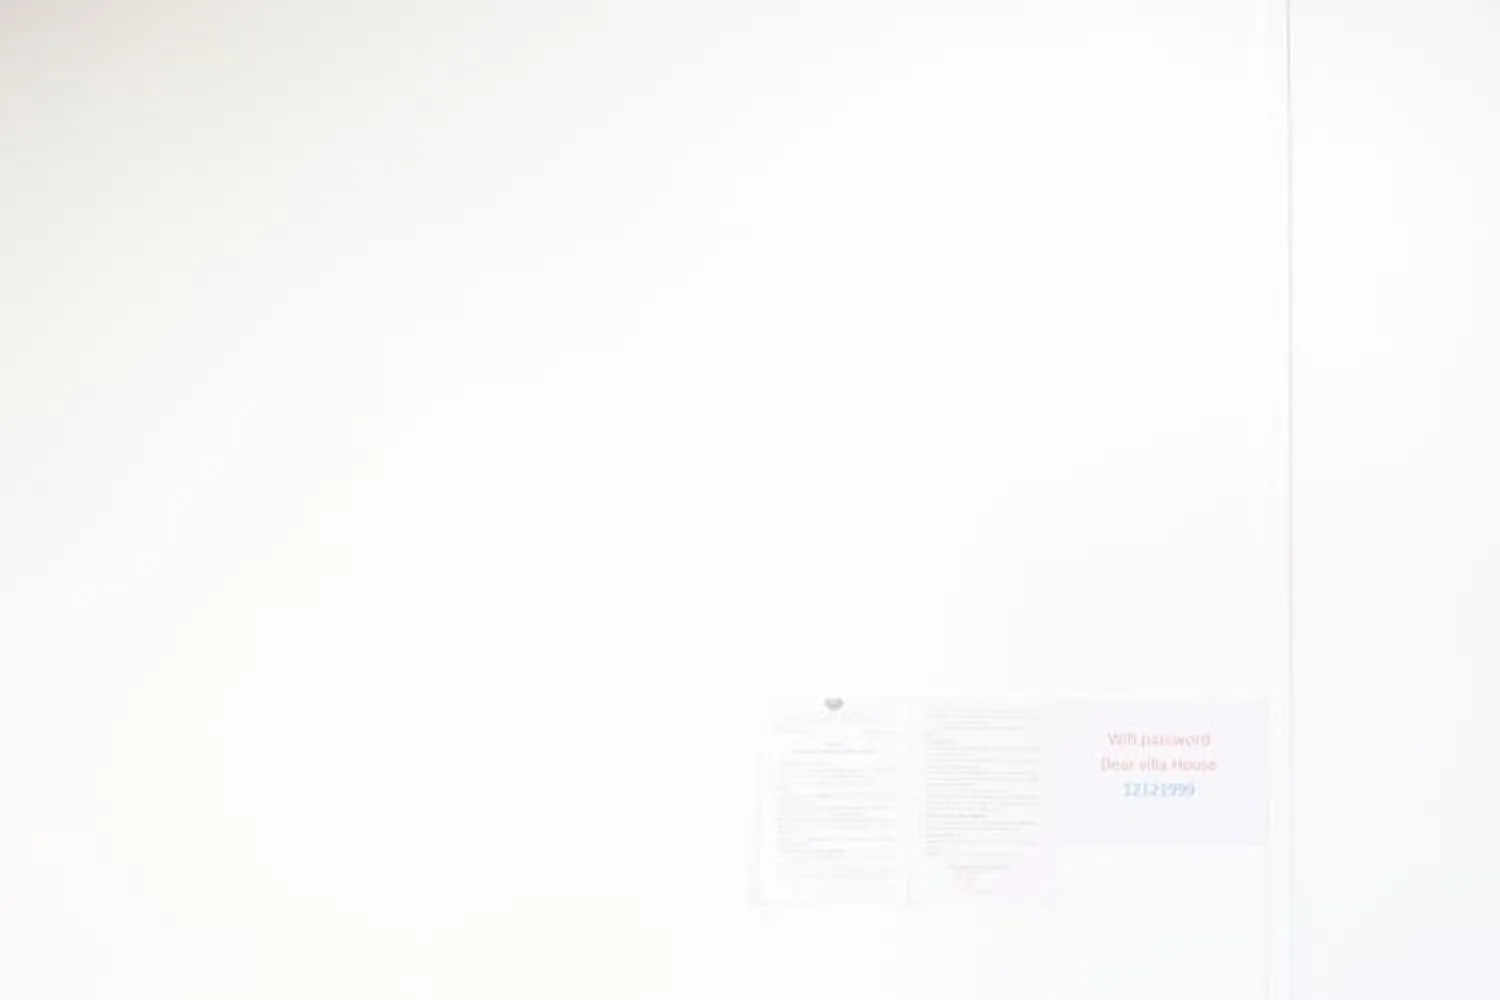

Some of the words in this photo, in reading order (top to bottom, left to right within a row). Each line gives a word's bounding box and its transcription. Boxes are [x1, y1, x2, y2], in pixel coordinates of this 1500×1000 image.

[1107, 732, 1136, 746] Wifi
[1141, 733, 1211, 748] password
[1101, 757, 1134, 771] Dear
[1172, 758, 1217, 771] House
[1124, 782, 1195, 797] 12121999
